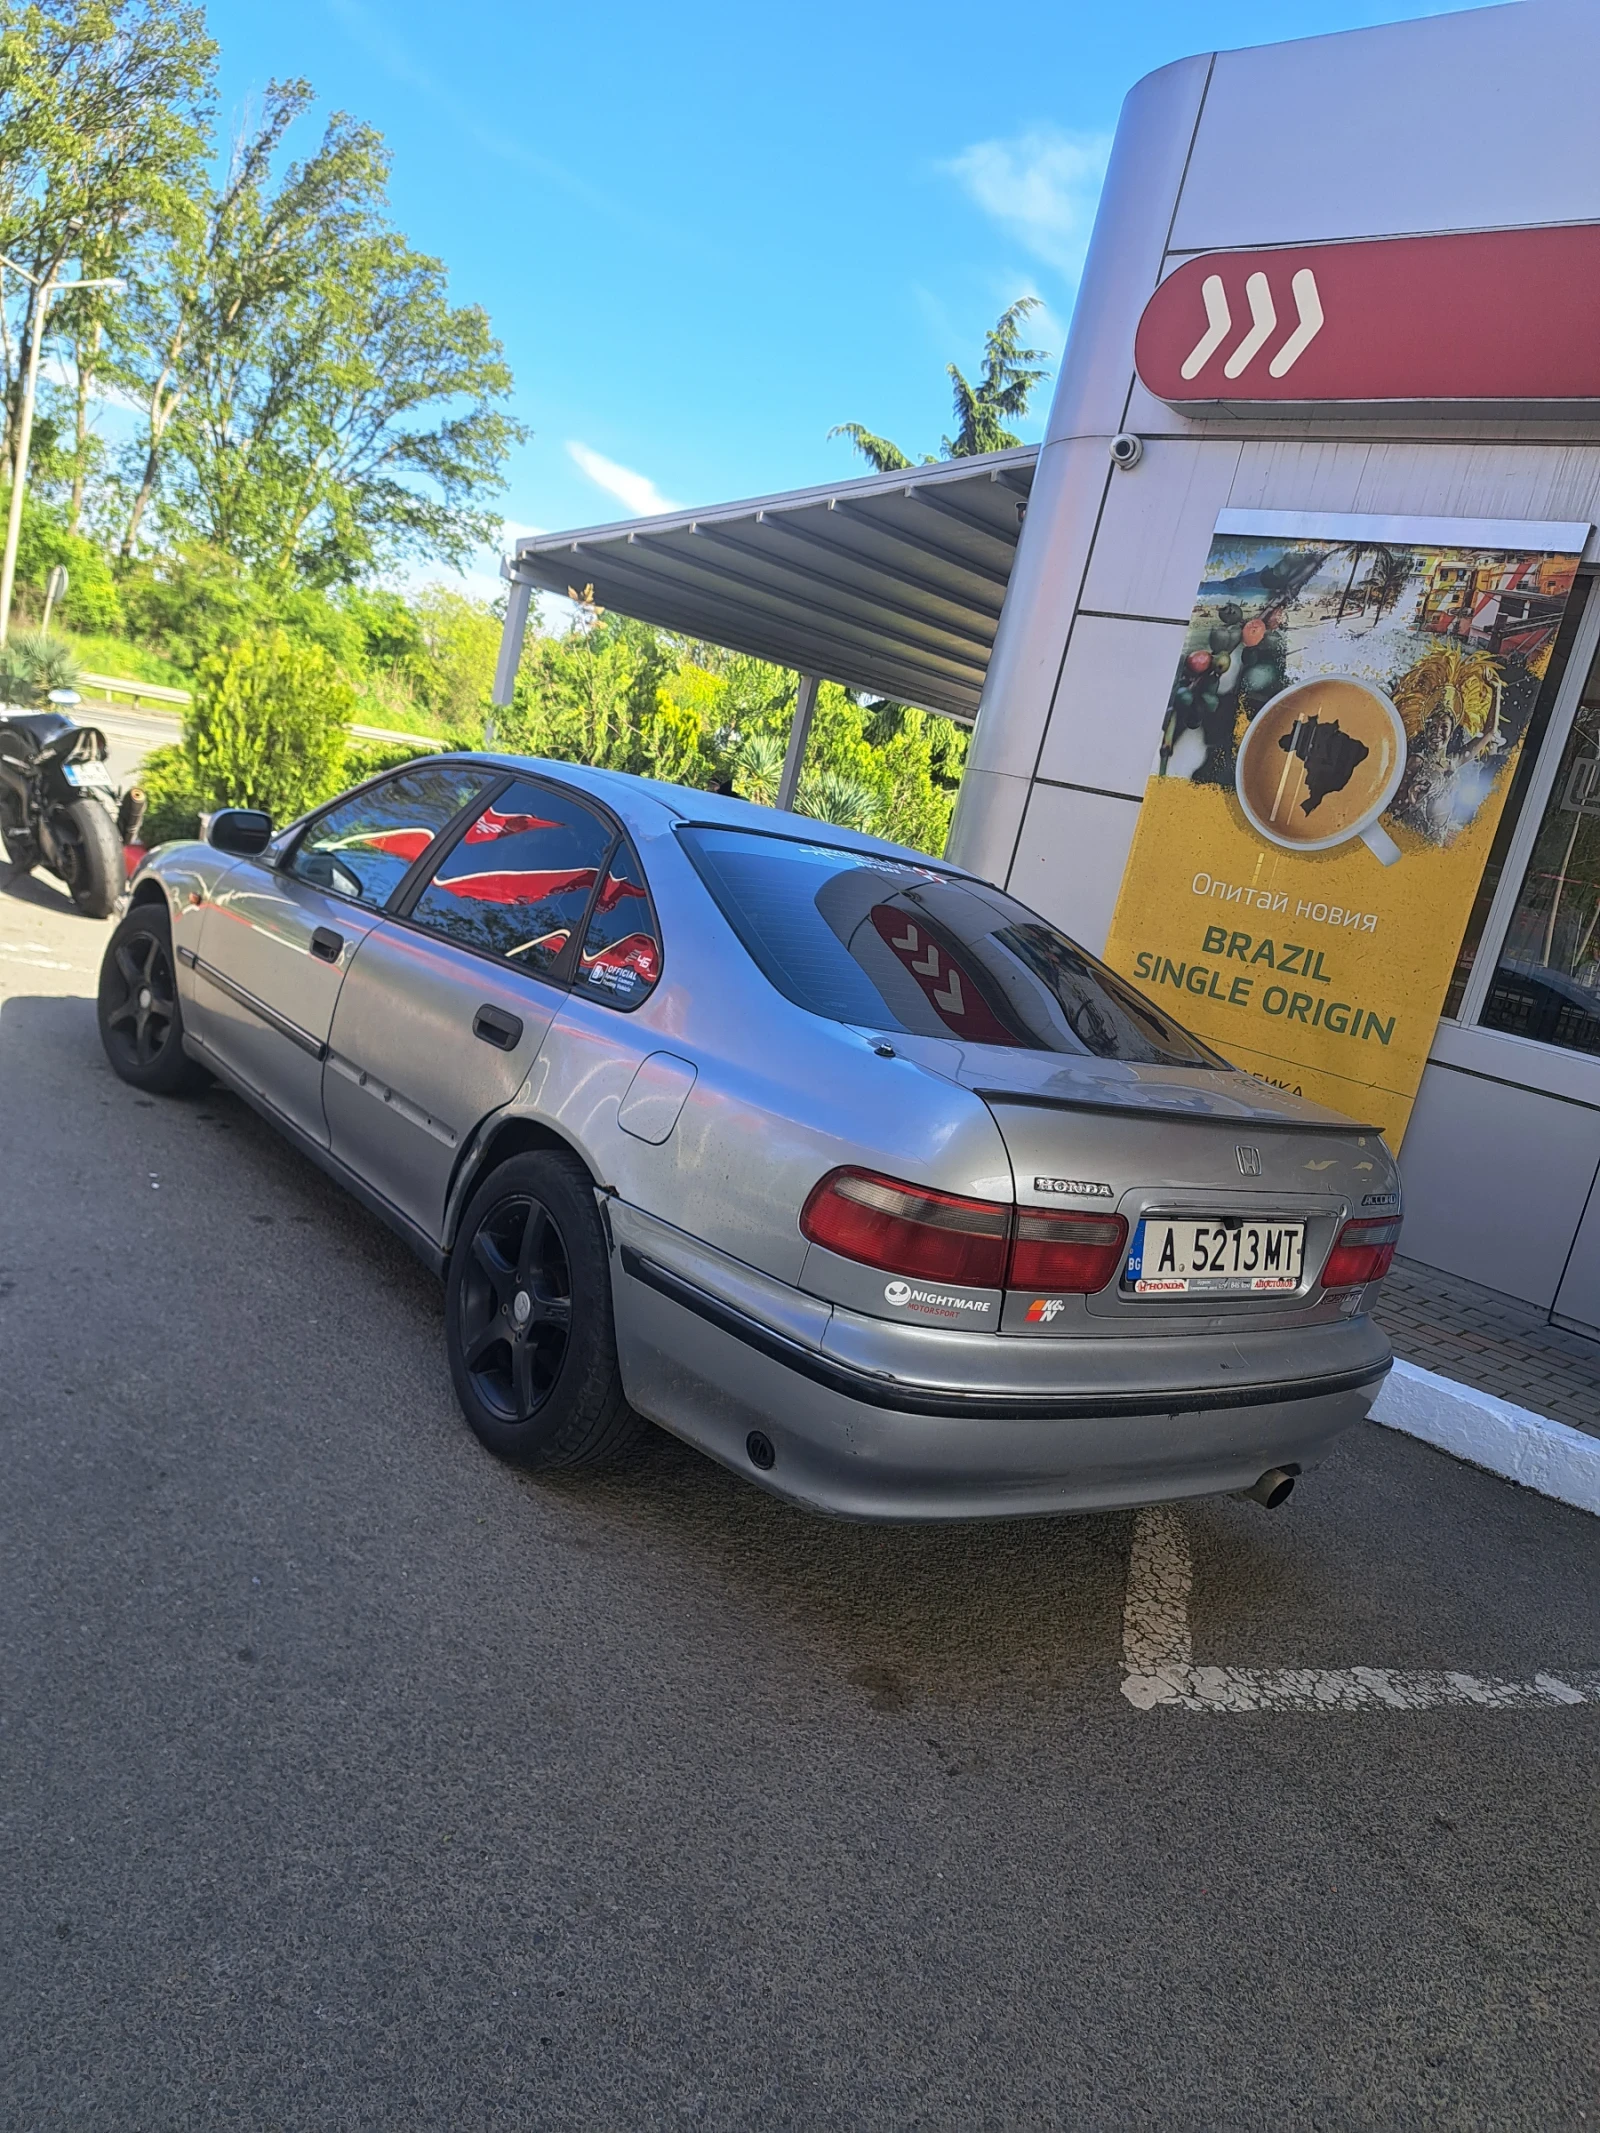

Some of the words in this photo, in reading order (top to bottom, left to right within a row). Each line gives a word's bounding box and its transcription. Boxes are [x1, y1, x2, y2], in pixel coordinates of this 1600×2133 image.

[1191, 873, 1289, 913] Опитай
[1295, 900, 1379, 933] новия
[1201, 925, 1332, 983] BRAZIL
[607, 965, 638, 981] OFFICIAL
[1133, 951, 1254, 1007] SINGLE
[1262, 986, 1396, 1045] ORIGIN
[1036, 1178, 1112, 1197] HONDA
[1363, 1194, 1396, 1205] ACCORD
[1128, 1257, 1142, 1271] BG
[1148, 1282, 1185, 1291] HONDA
[911, 1289, 991, 1312] NIGHTMARE
[907, 1302, 961, 1319] MOTORSPORT
